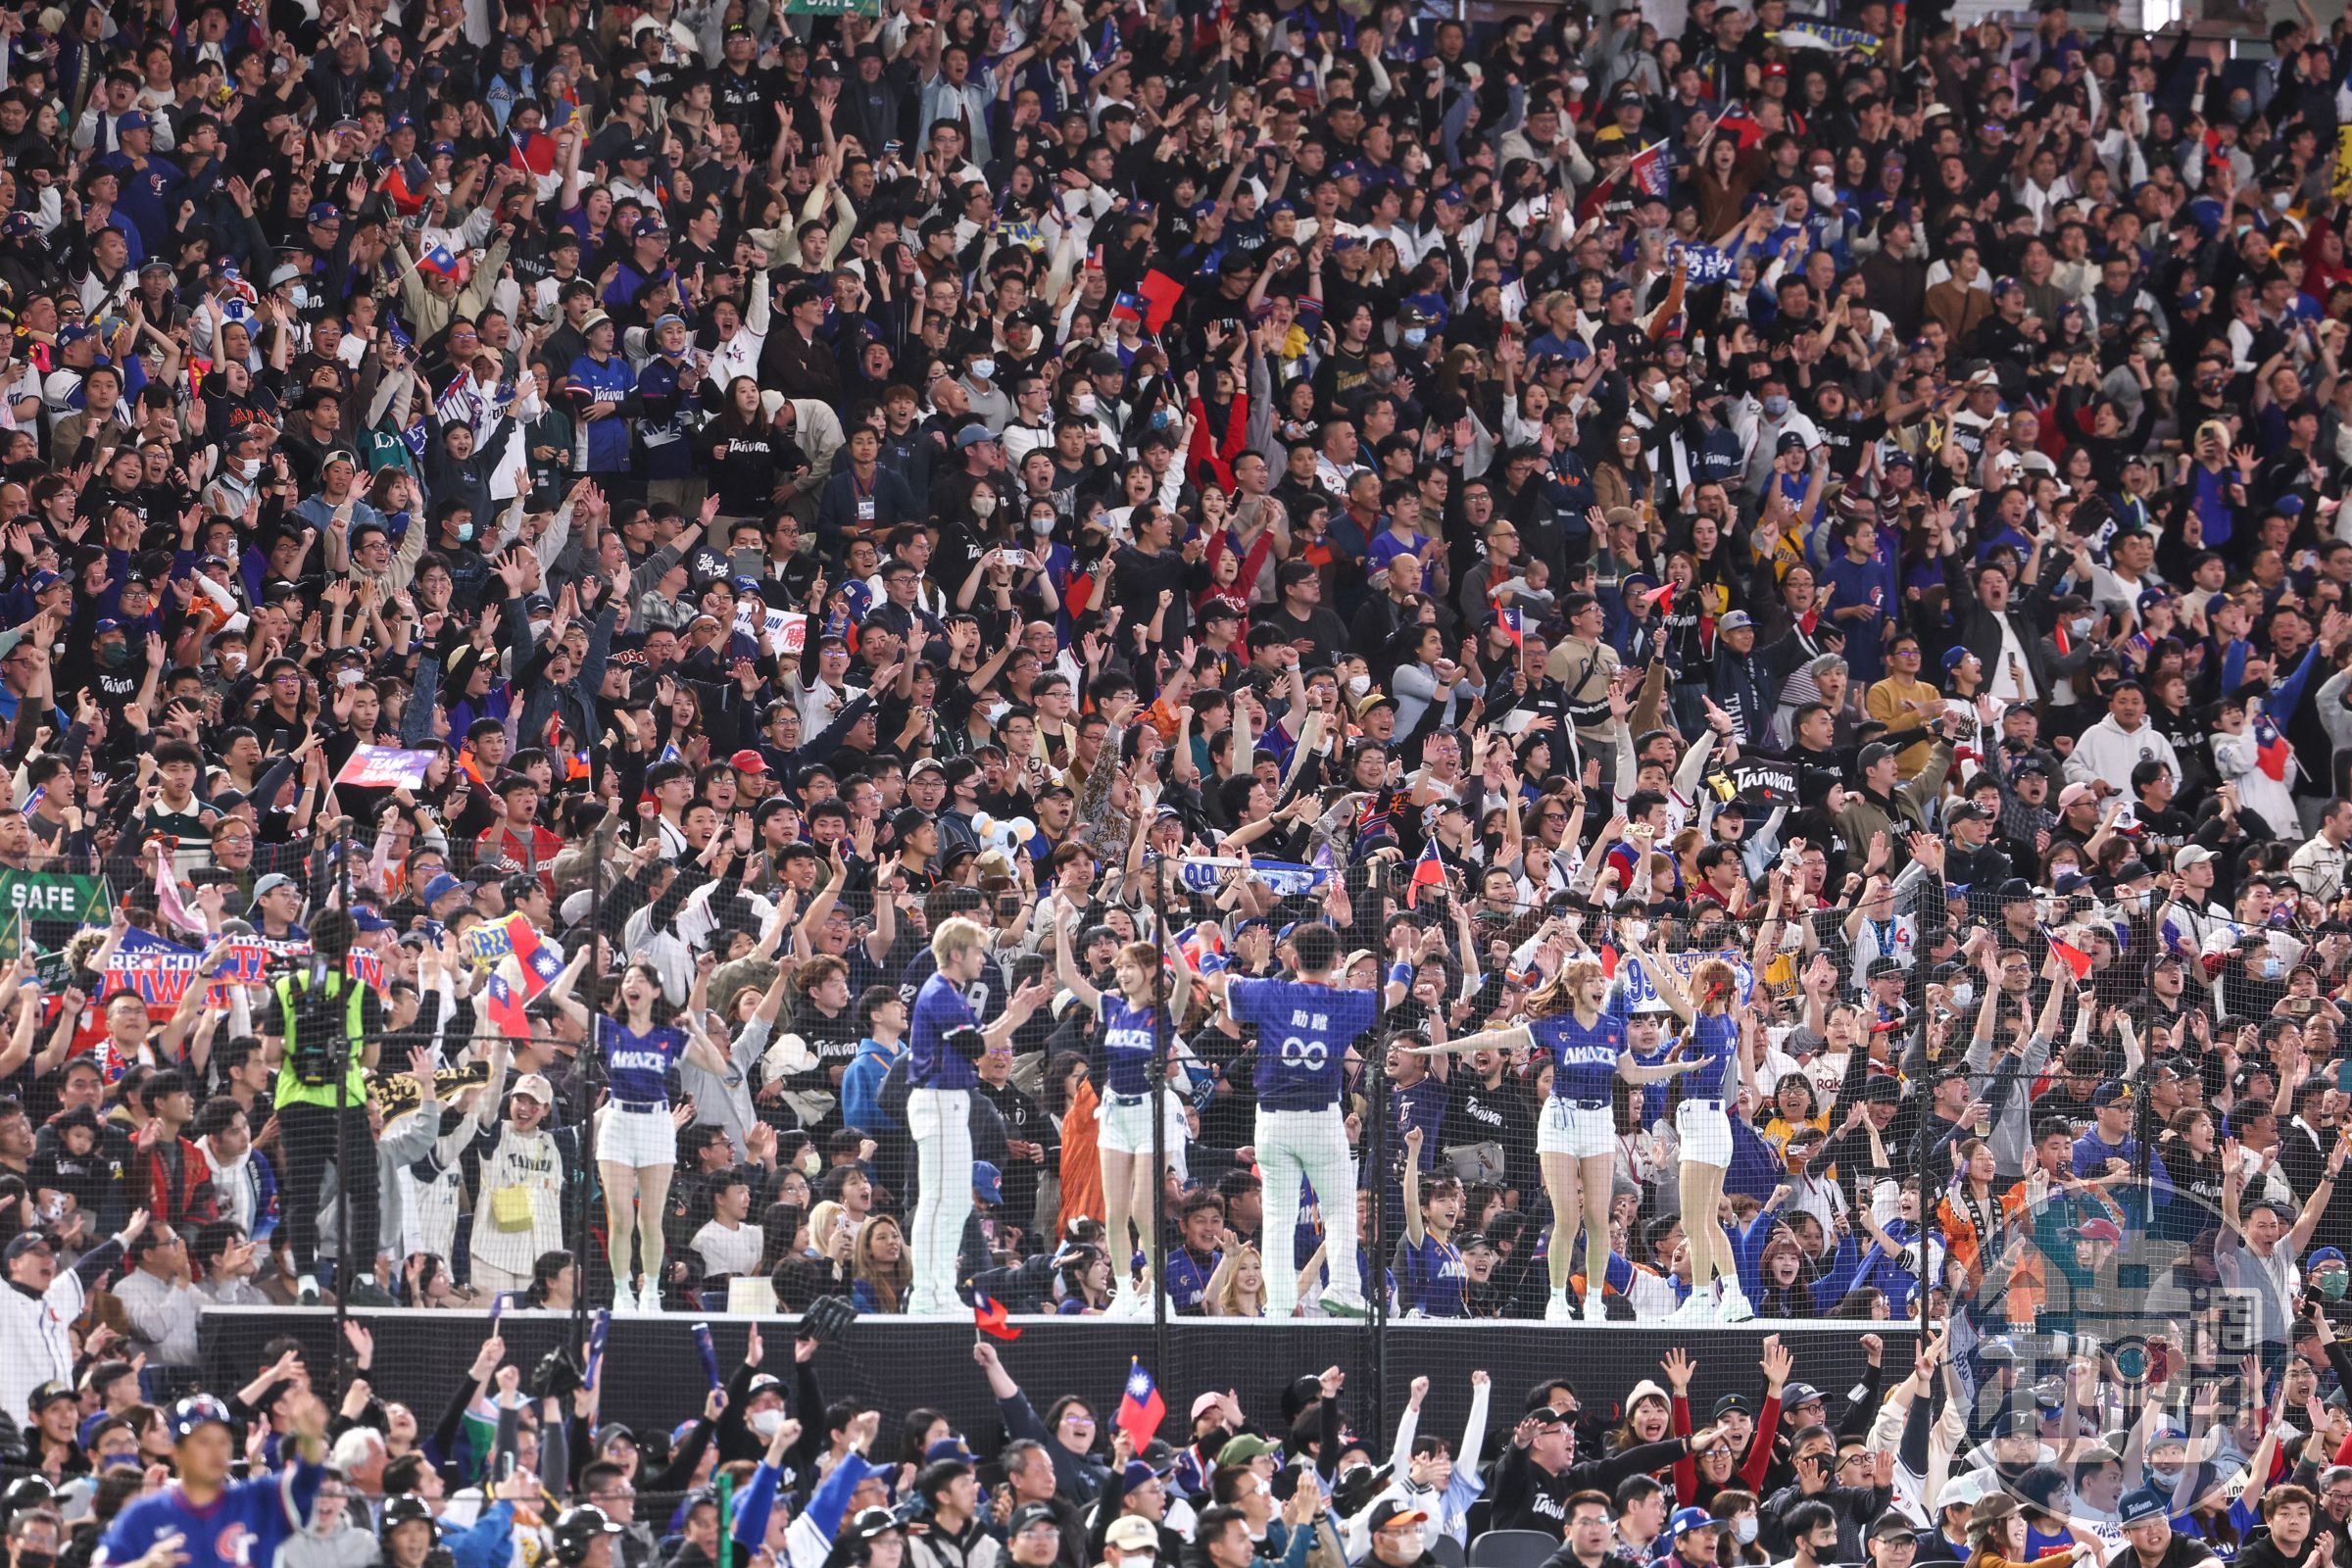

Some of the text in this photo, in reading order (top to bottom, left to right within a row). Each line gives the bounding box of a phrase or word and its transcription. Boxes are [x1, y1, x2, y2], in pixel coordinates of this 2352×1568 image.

[594, 384, 625, 403] Taiwan
[728, 437, 771, 454] Taiwan
[1733, 765, 1797, 794] Taiwan
[12, 883, 75, 912] SAFE
[610, 1050, 666, 1075] AMAZE
[1563, 1045, 1617, 1067] AMAZE
